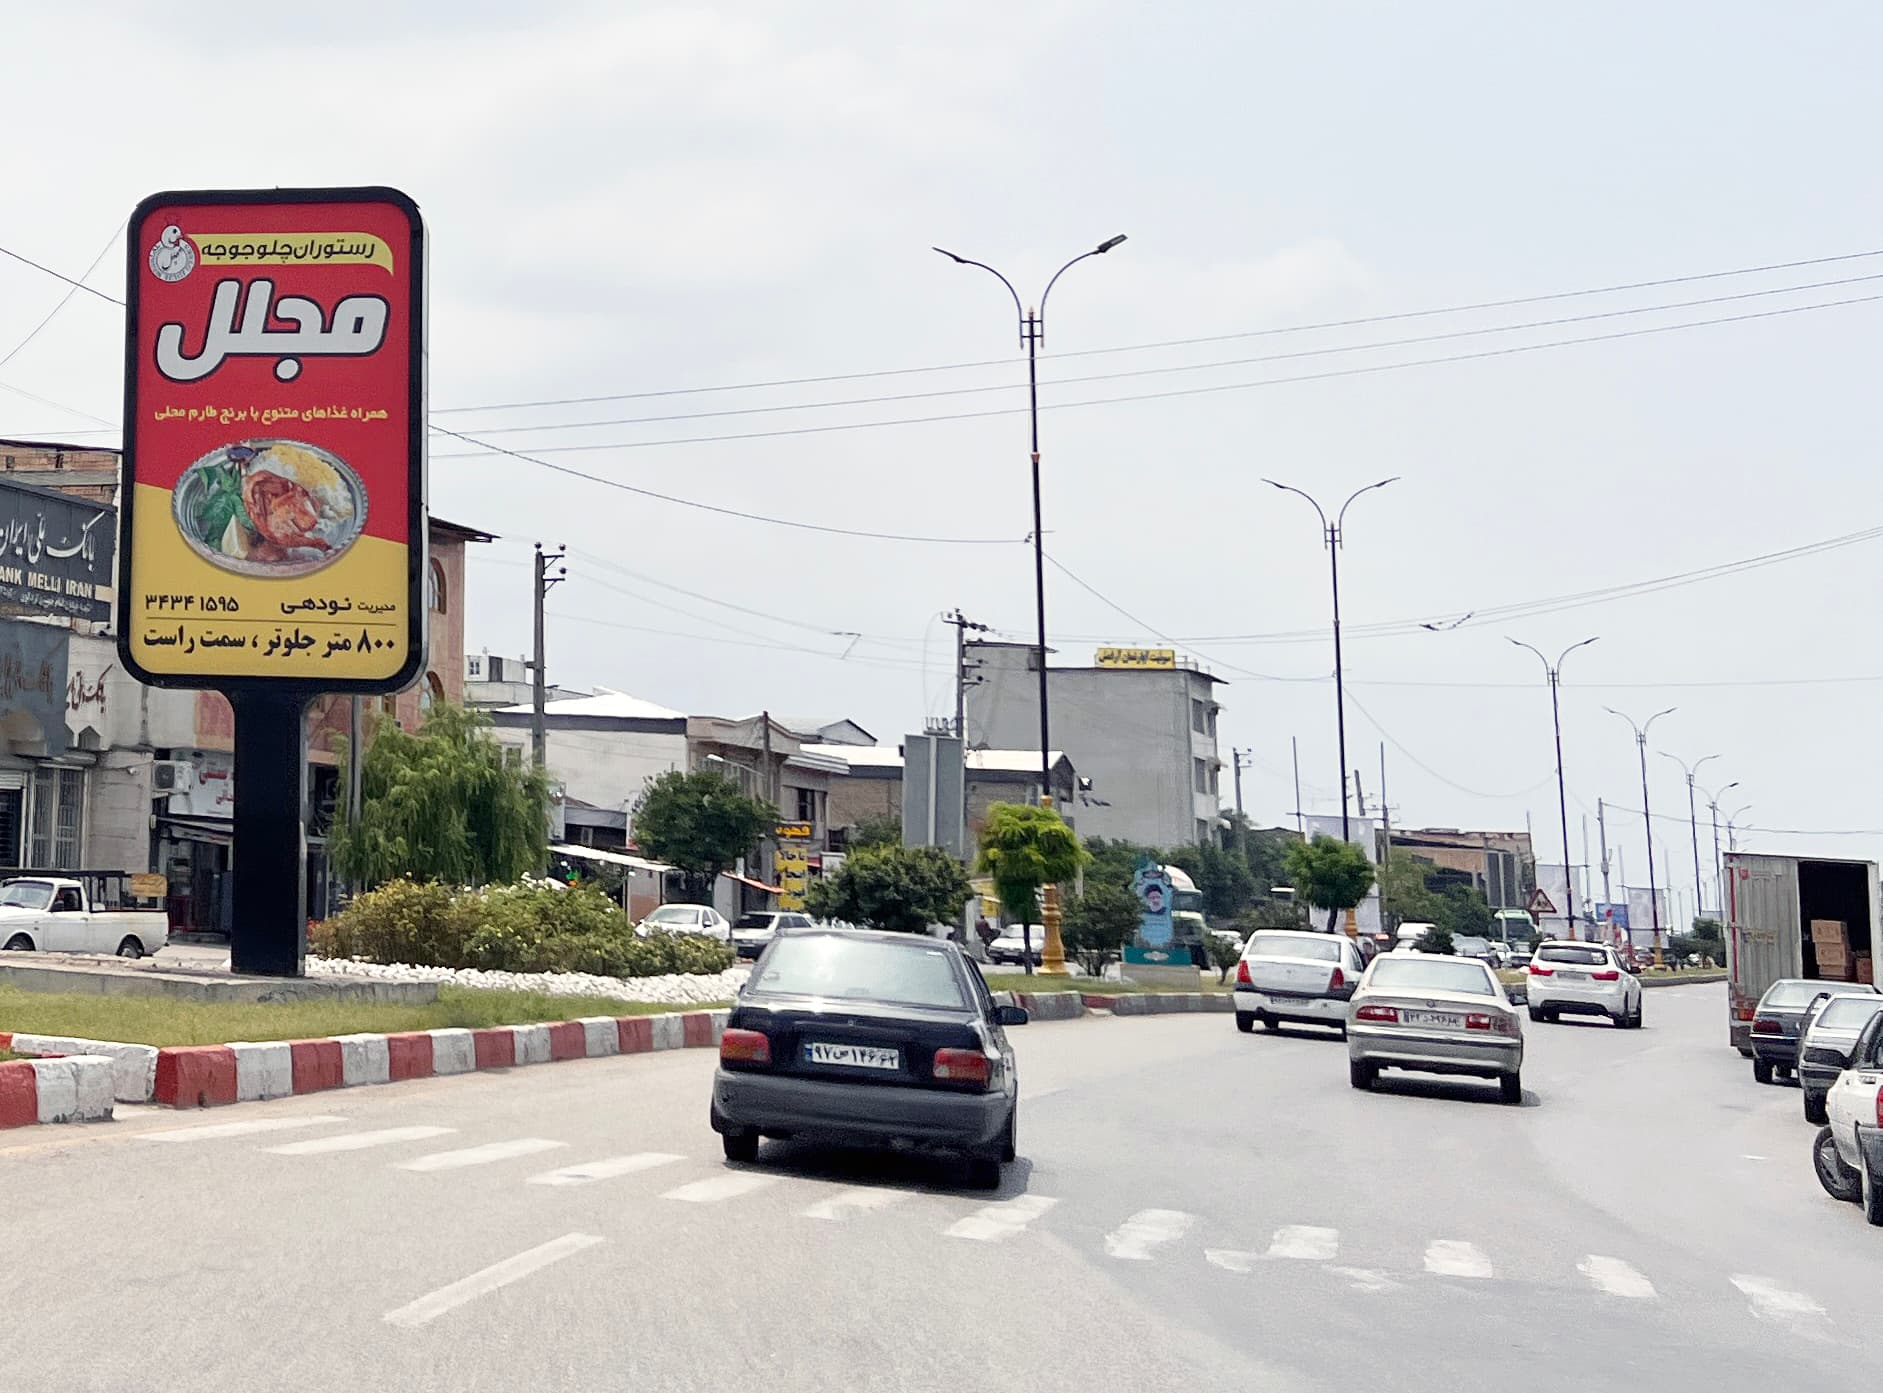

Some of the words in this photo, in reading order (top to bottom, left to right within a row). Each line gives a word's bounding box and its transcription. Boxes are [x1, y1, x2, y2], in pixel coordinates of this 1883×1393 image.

[293, 239, 376, 259] رستوران
[154, 277, 390, 383] مجلل
[154, 405, 186, 421] محلی
[188, 405, 217, 421] طارم
[219, 407, 247, 425] برنج
[249, 405, 259, 422] با
[261, 407, 299, 425] متنوع
[302, 405, 348, 422] غذاهای
[350, 407, 388, 422] همراه
[0, 565, 22, 586] ANK
[27, 571, 61, 593] MELLI
[65, 578, 92, 599] IRAN
[281, 597, 352, 615] نودهی
[357, 602, 396, 614] مدیریت
[143, 625, 195, 654] راست
[200, 630, 245, 648] سمت
[321, 633, 353, 658] متر
[357, 628, 395, 654] ۸۰۰
